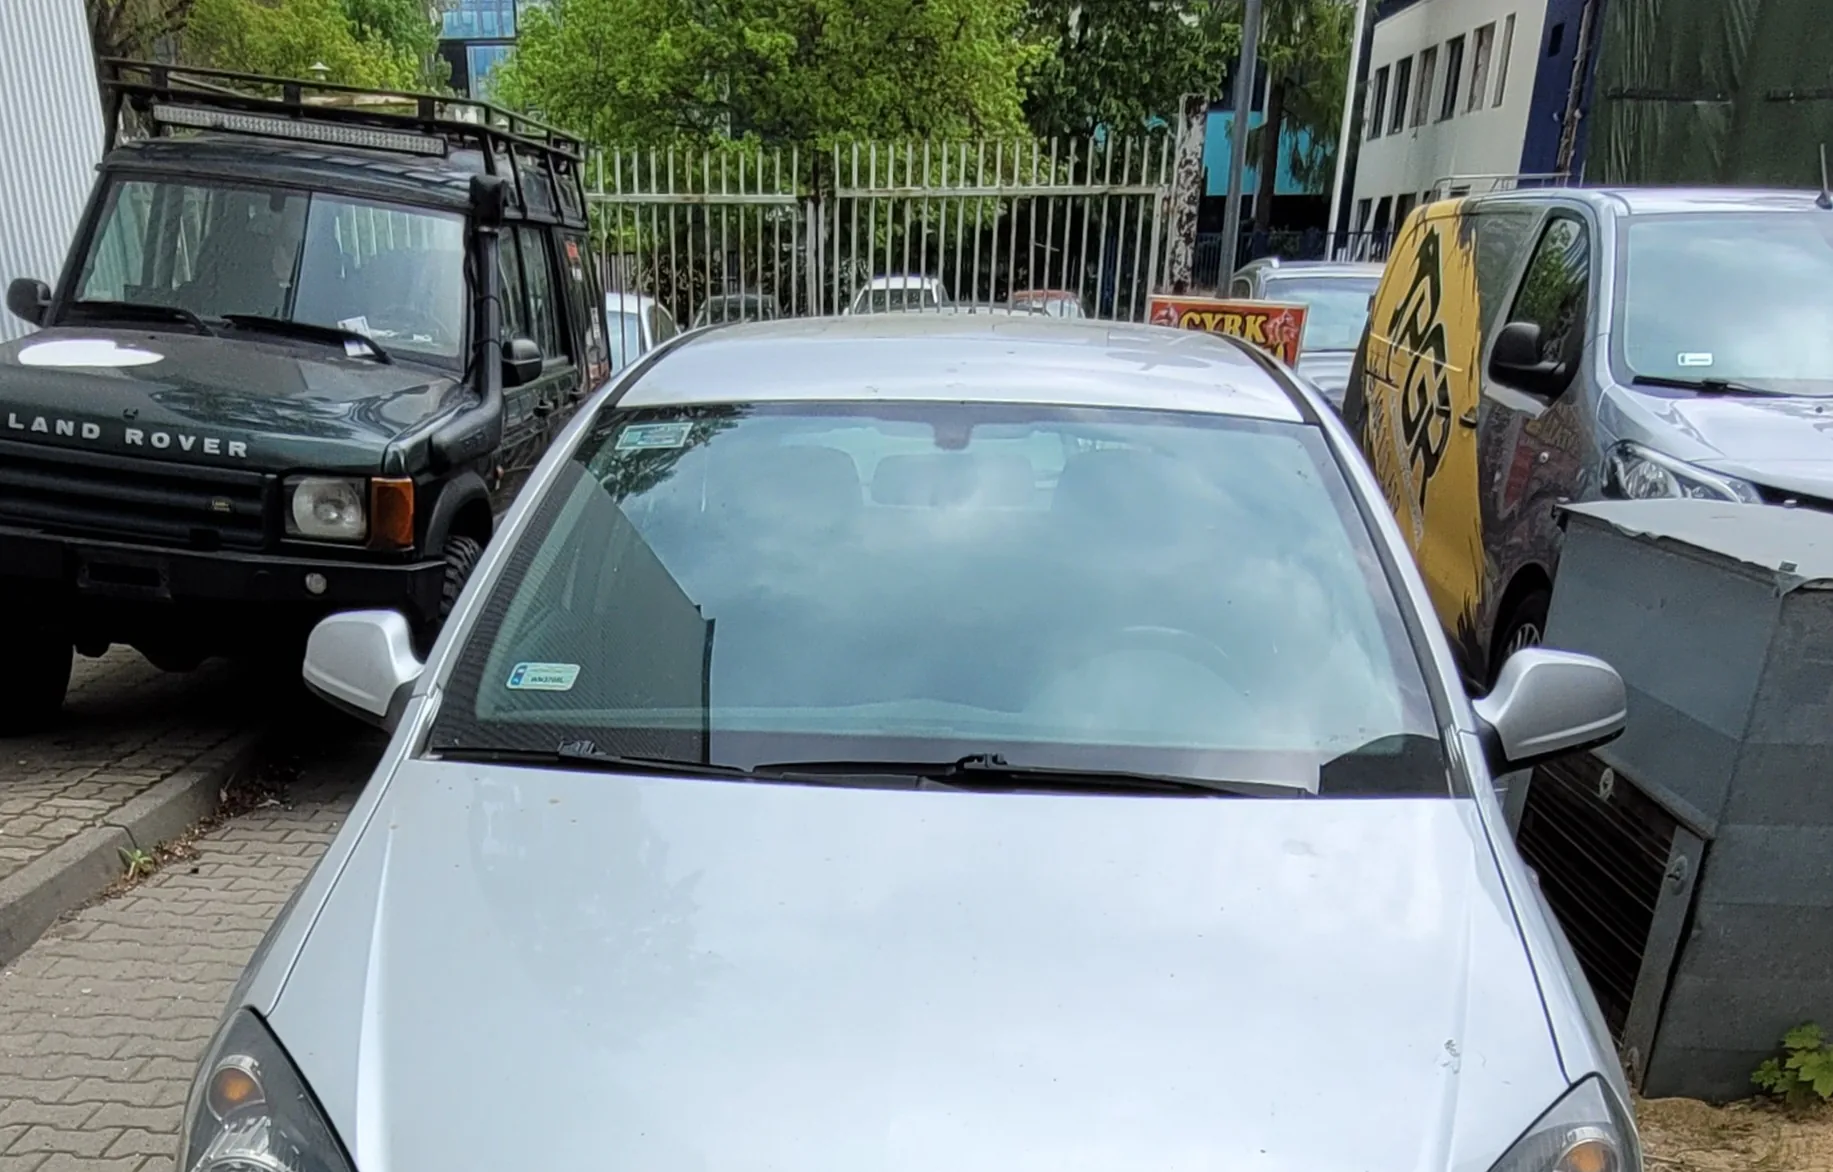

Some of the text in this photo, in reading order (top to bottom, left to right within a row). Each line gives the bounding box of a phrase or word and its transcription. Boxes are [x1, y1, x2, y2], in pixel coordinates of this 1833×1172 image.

[1179, 311, 1268, 345] CYRK
[8, 412, 248, 459] LAND ROVER
